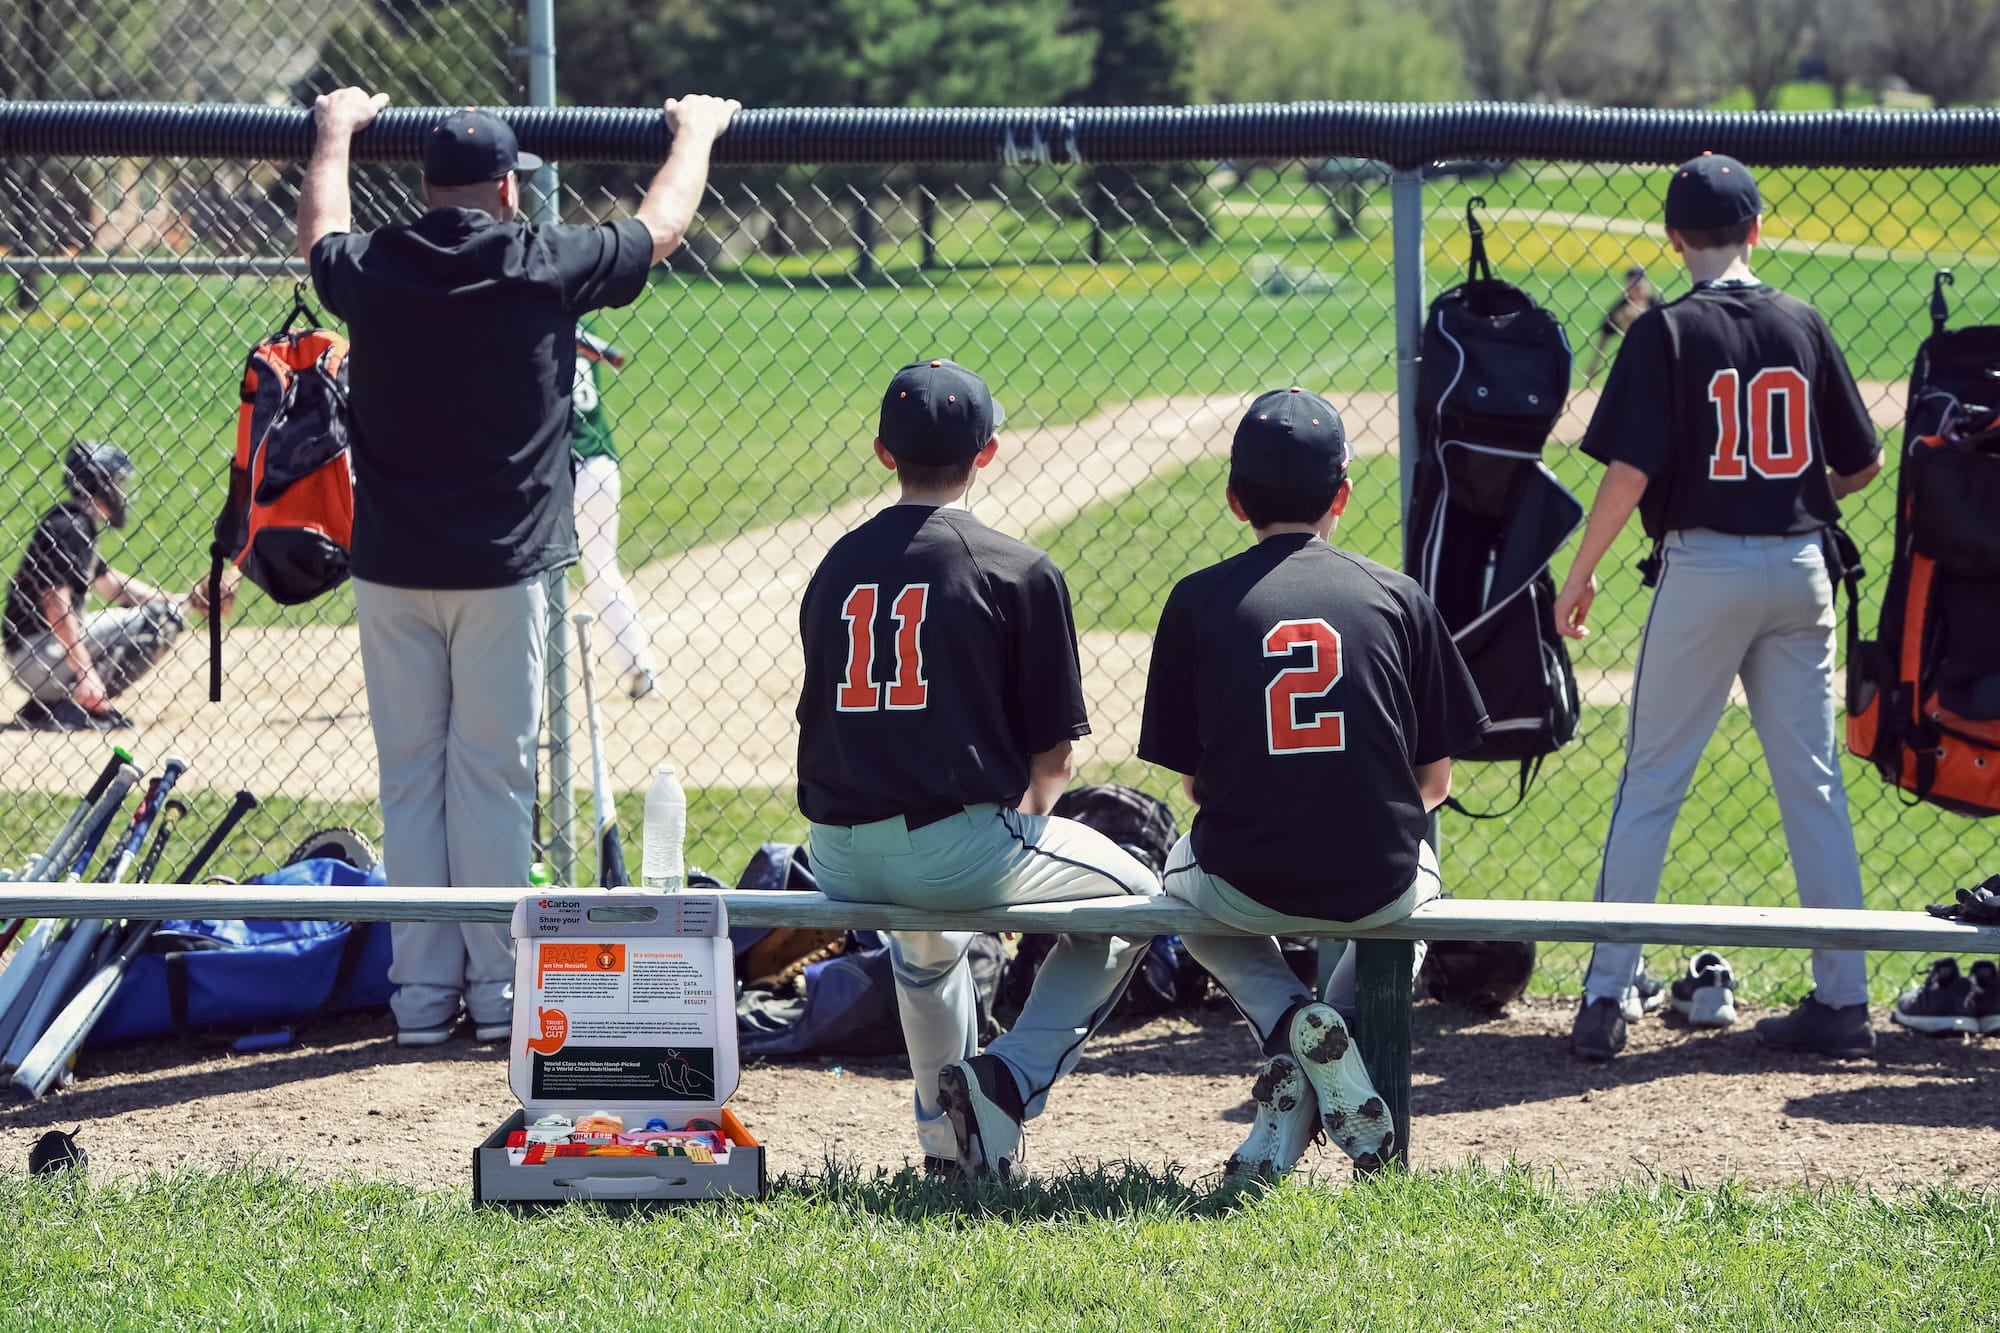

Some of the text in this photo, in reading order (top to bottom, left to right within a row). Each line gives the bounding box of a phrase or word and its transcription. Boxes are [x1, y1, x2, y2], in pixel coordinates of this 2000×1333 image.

[1708, 366, 1813, 481] 10
[836, 583, 929, 713] 11
[1262, 618, 1345, 756] 2
[547, 900, 580, 908] Carbon
[539, 916, 580, 925] Share your
[539, 924, 560, 932] story
[543, 946, 588, 963] PAC
